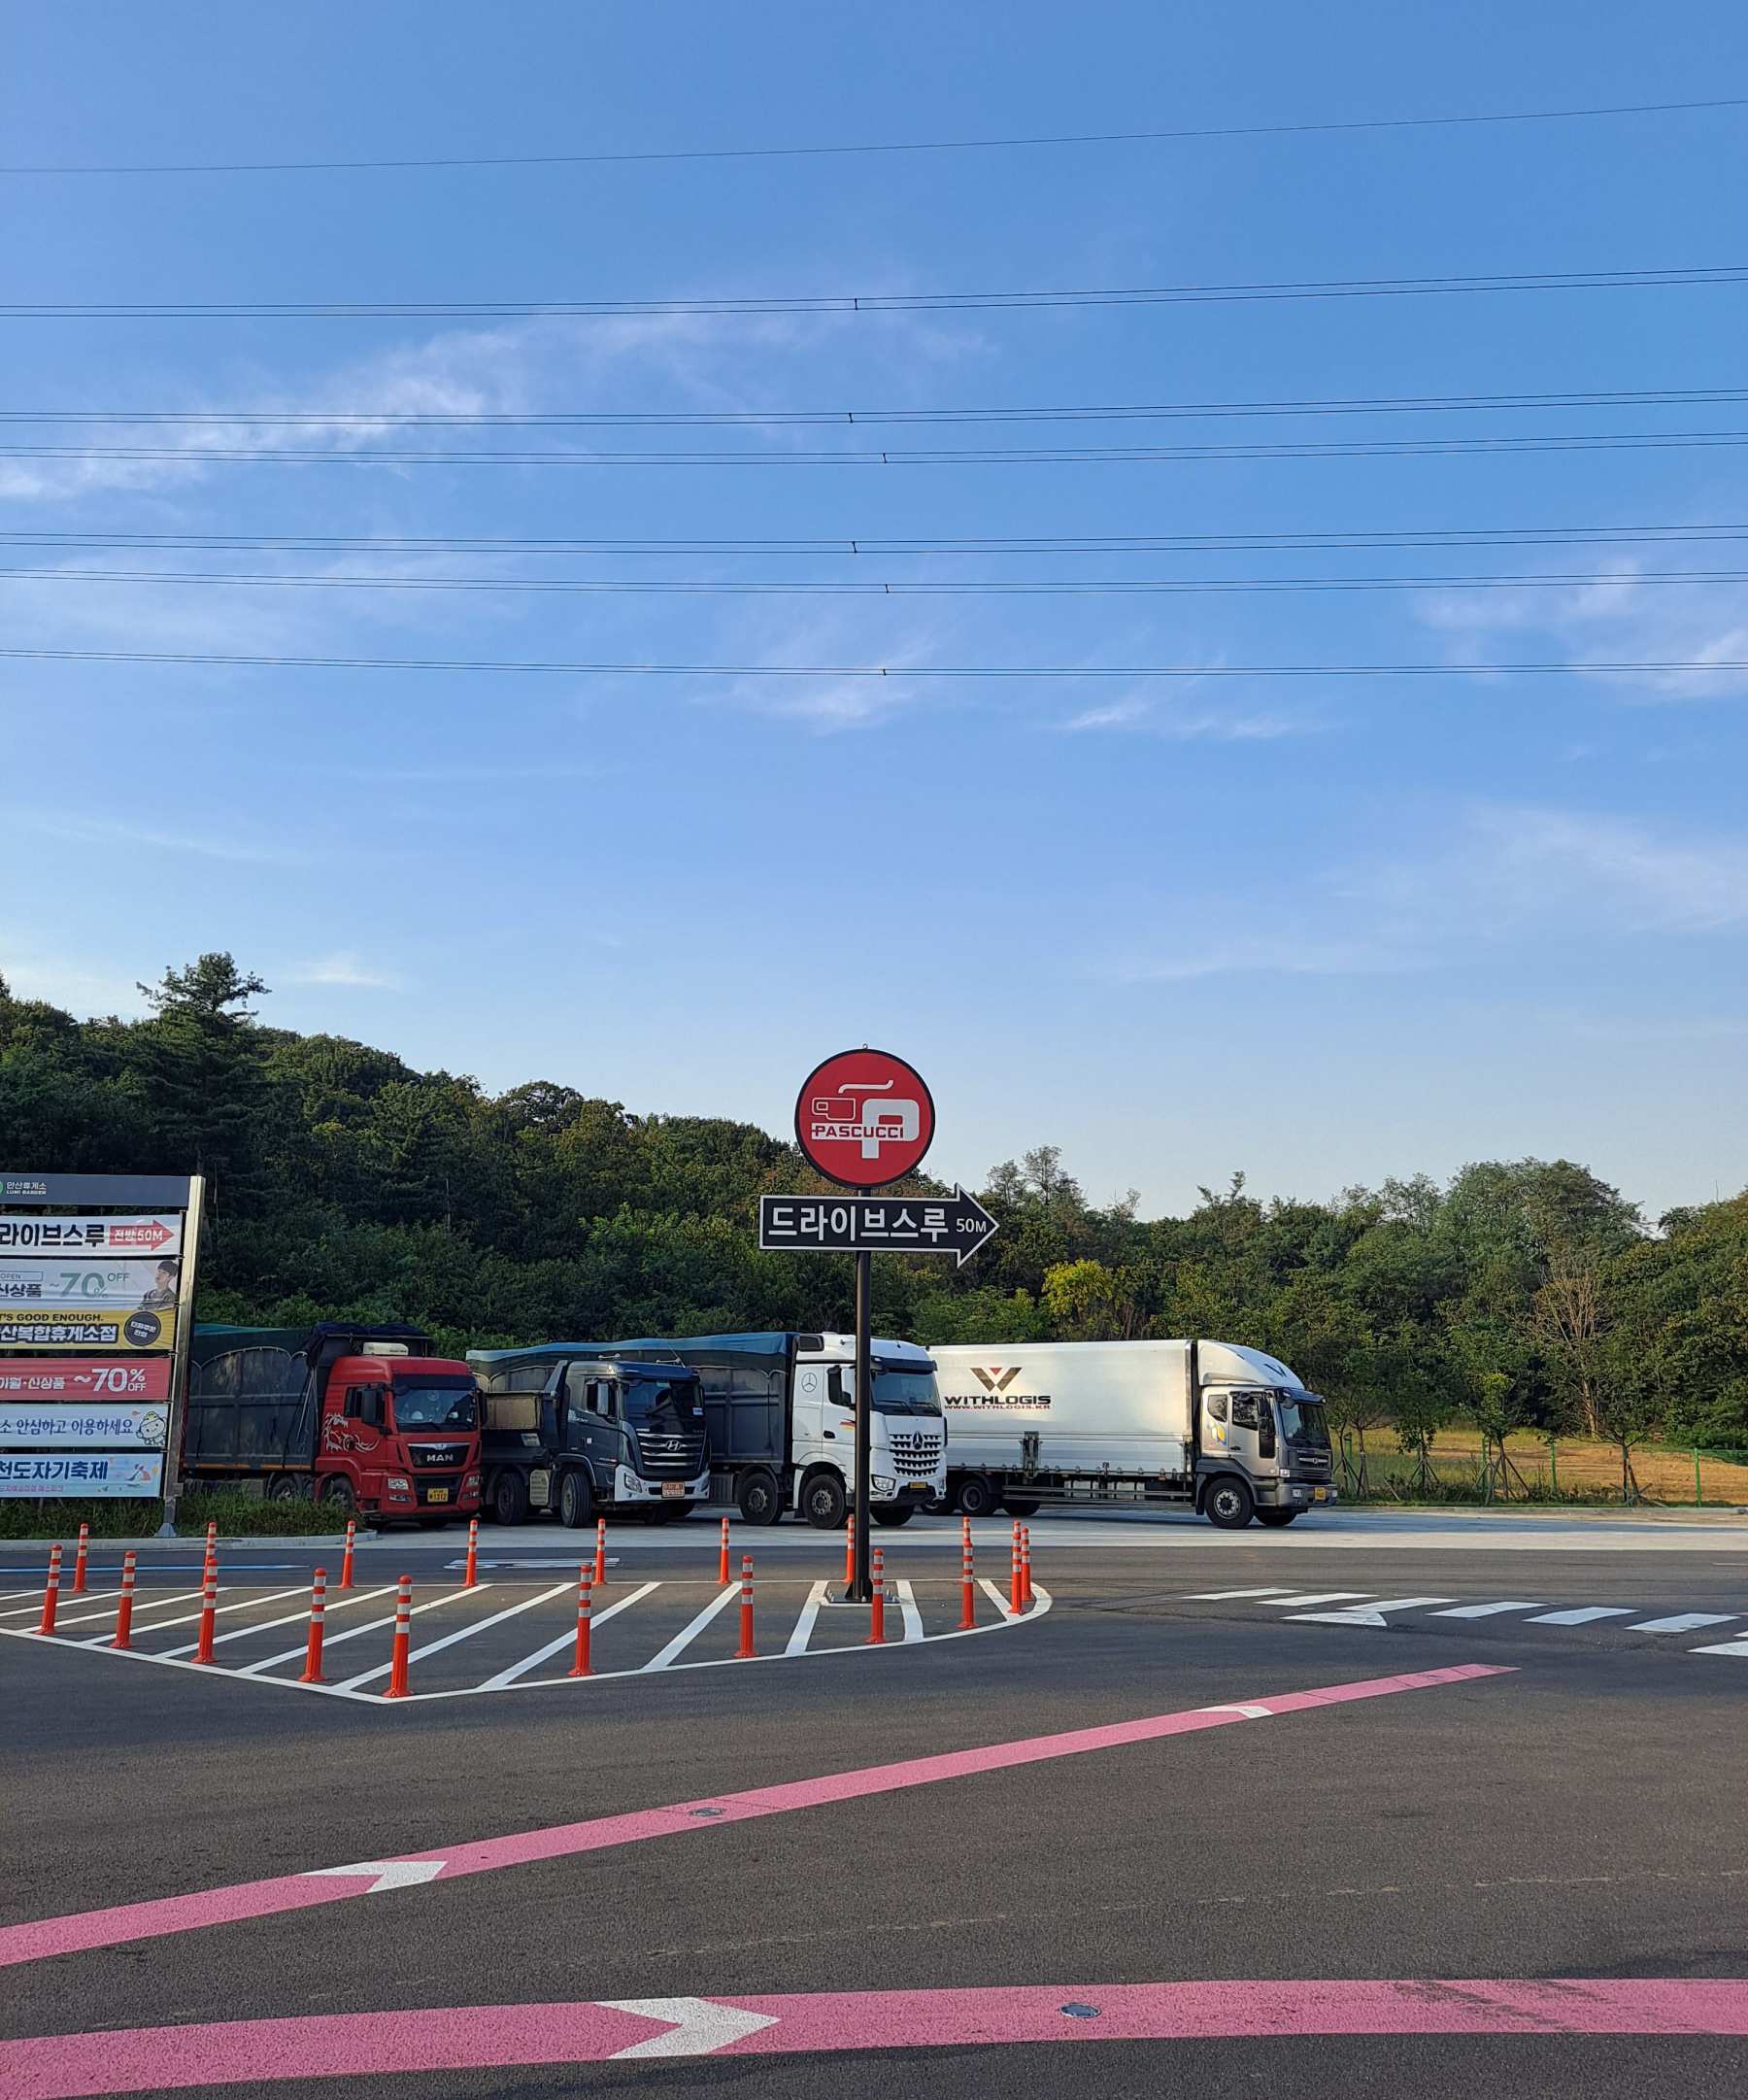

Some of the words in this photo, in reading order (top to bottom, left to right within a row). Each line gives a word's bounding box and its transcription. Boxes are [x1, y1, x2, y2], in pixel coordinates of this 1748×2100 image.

[814, 1125, 904, 1139] PASCUCCI
[768, 1204, 949, 1243] 드라이브스루
[956, 1218, 988, 1234] 50M
[107, 1272, 130, 1282] OFF
[17, 1313, 50, 1322] GOOD
[51, 1313, 104, 1322] ENOUGH.
[0, 1325, 118, 1342] 산복합휴게소점
[127, 1383, 147, 1392] OFF
[944, 1396, 1051, 1405] WITHLOGIS
[16, 1418, 67, 1436] 안심하고
[71, 1419, 133, 1436] 이용하세요
